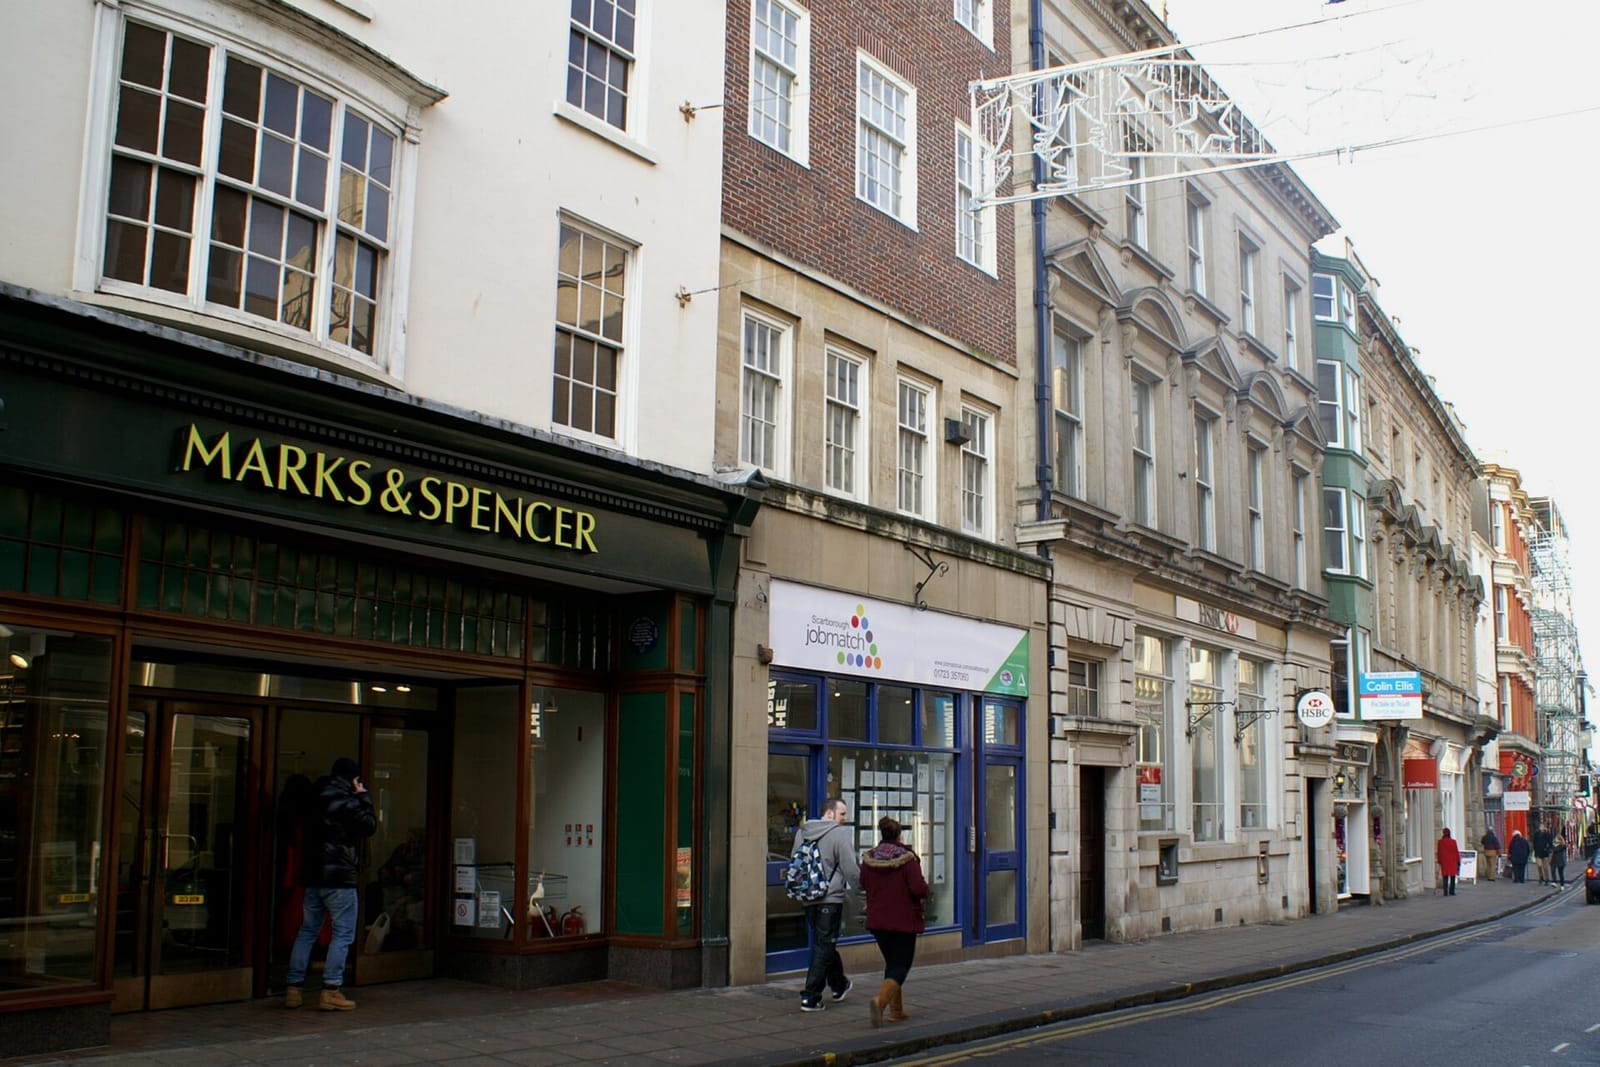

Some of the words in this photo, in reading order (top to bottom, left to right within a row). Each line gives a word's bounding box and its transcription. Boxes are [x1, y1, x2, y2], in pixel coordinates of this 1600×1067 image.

[182, 422, 373, 507] MARKS
[380, 468, 413, 516] &
[418, 475, 600, 554] SPENCER
[811, 614, 850, 631] Scarborough
[805, 623, 865, 651] jobmatch
[1366, 680, 1394, 691] Colin
[1395, 680, 1415, 691] Ellis
[1301, 709, 1330, 718] HSBC
